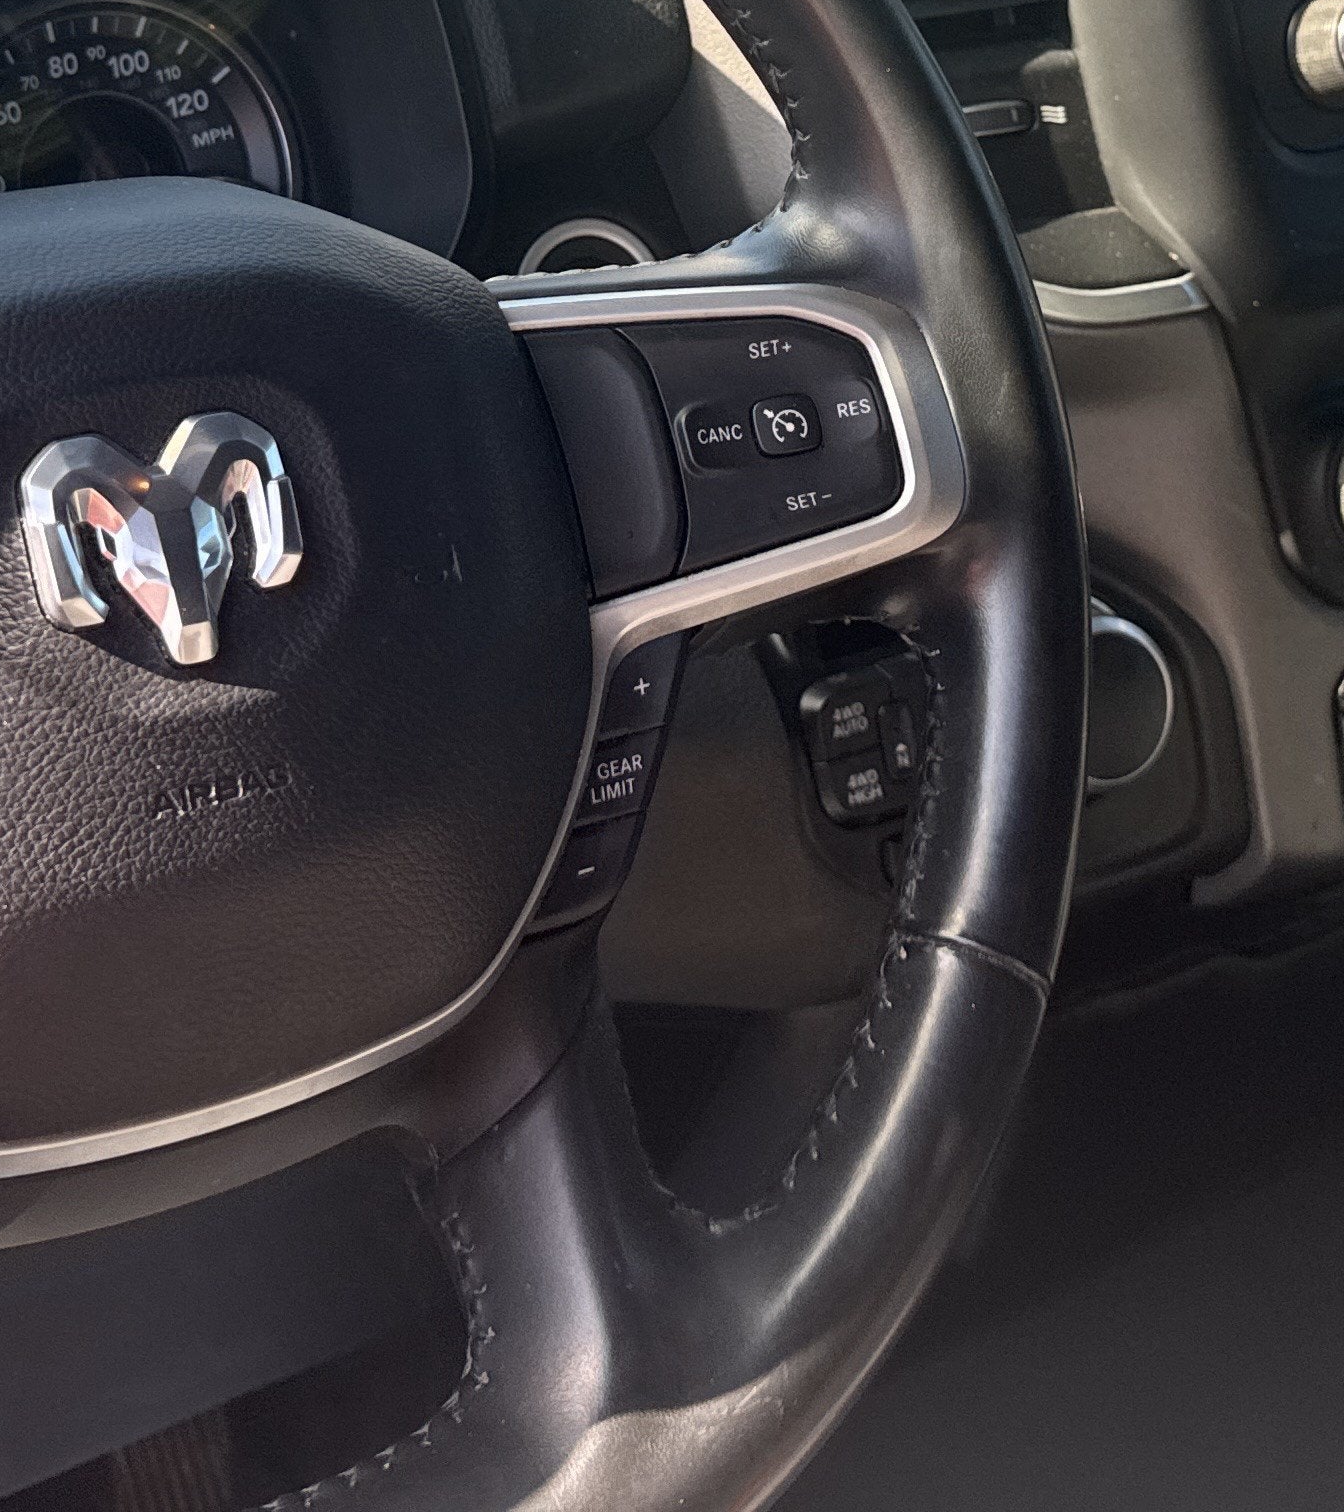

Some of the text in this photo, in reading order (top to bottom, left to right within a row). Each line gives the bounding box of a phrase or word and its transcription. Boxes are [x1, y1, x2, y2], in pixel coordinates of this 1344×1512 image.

[86, 45, 106, 61] 90
[47, 52, 79, 79] 80
[107, 50, 150, 79] 100
[155, 65, 182, 84] 110
[19, 75, 40, 92] 70
[165, 89, 209, 119] 120
[191, 125, 235, 149] MPH
[837, 398, 871, 419] RES
[697, 423, 743, 445] CANC
[834, 716, 869, 738] AUTO
[597, 753, 643, 780] GEAR
[591, 777, 636, 805] LIMIT
[848, 784, 883, 805] HIGH
